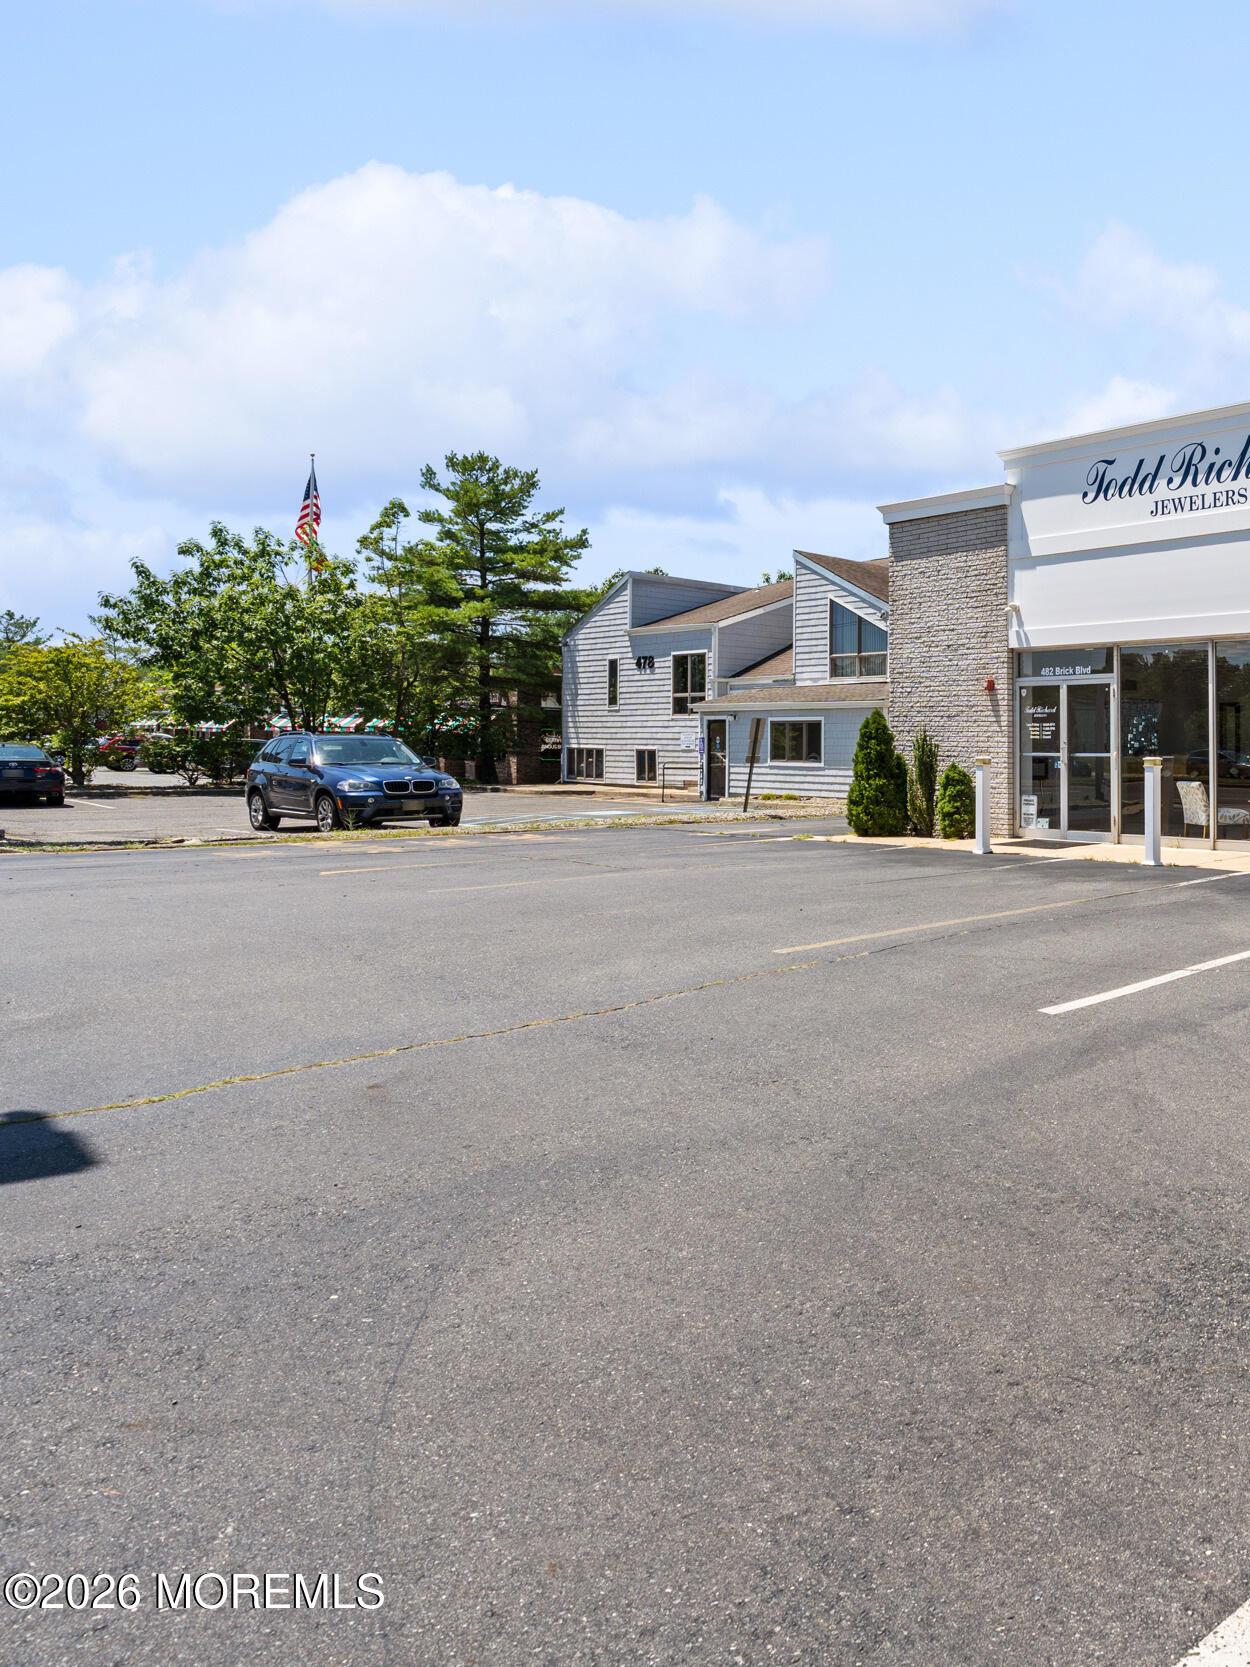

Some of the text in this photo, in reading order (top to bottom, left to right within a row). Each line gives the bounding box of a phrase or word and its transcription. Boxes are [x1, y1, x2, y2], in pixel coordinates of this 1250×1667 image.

[1082, 454, 1167, 505] Todd
[1150, 487, 1248, 517] JEWELERS
[635, 656, 655, 669] 478
[1041, 665, 1092, 676] 482 Brick Blvd
